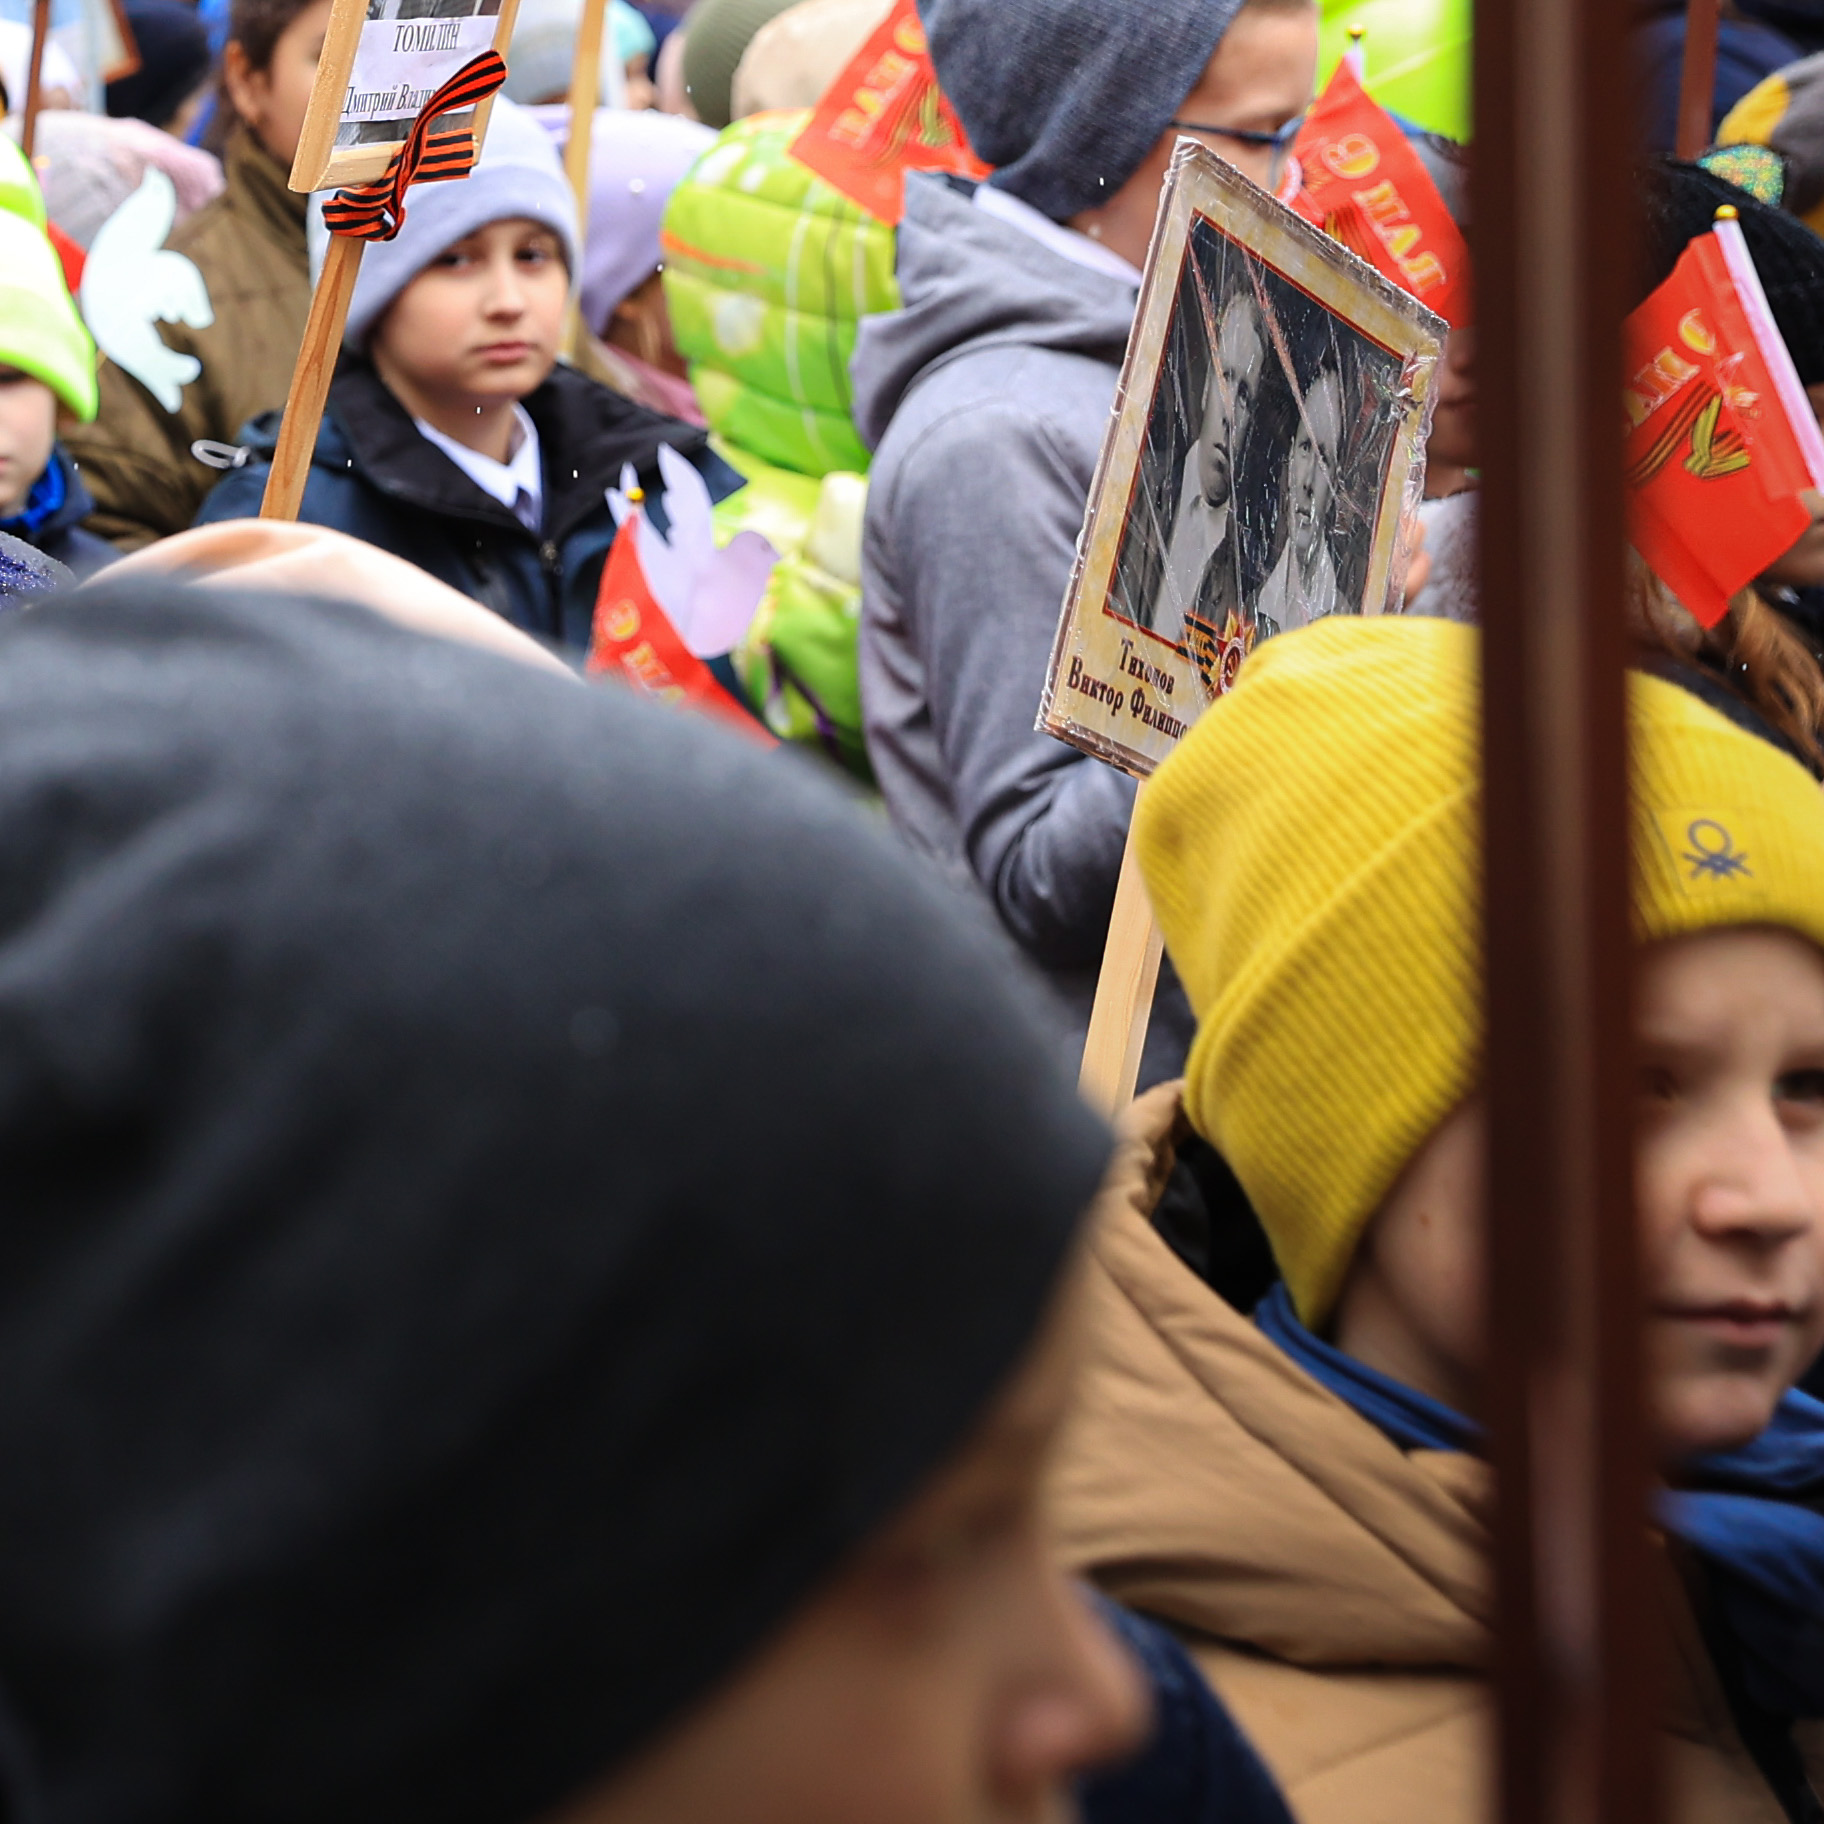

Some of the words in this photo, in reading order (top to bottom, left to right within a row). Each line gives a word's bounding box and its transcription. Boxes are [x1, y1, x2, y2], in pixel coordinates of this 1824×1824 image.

[393, 23, 461, 53] ТОМИЛИН
[341, 84, 398, 120] Дмитрий
[1118, 637, 1175, 695] Тихонов
[1066, 655, 1125, 717] Виктор
[1129, 686, 1192, 740] Филиппо
